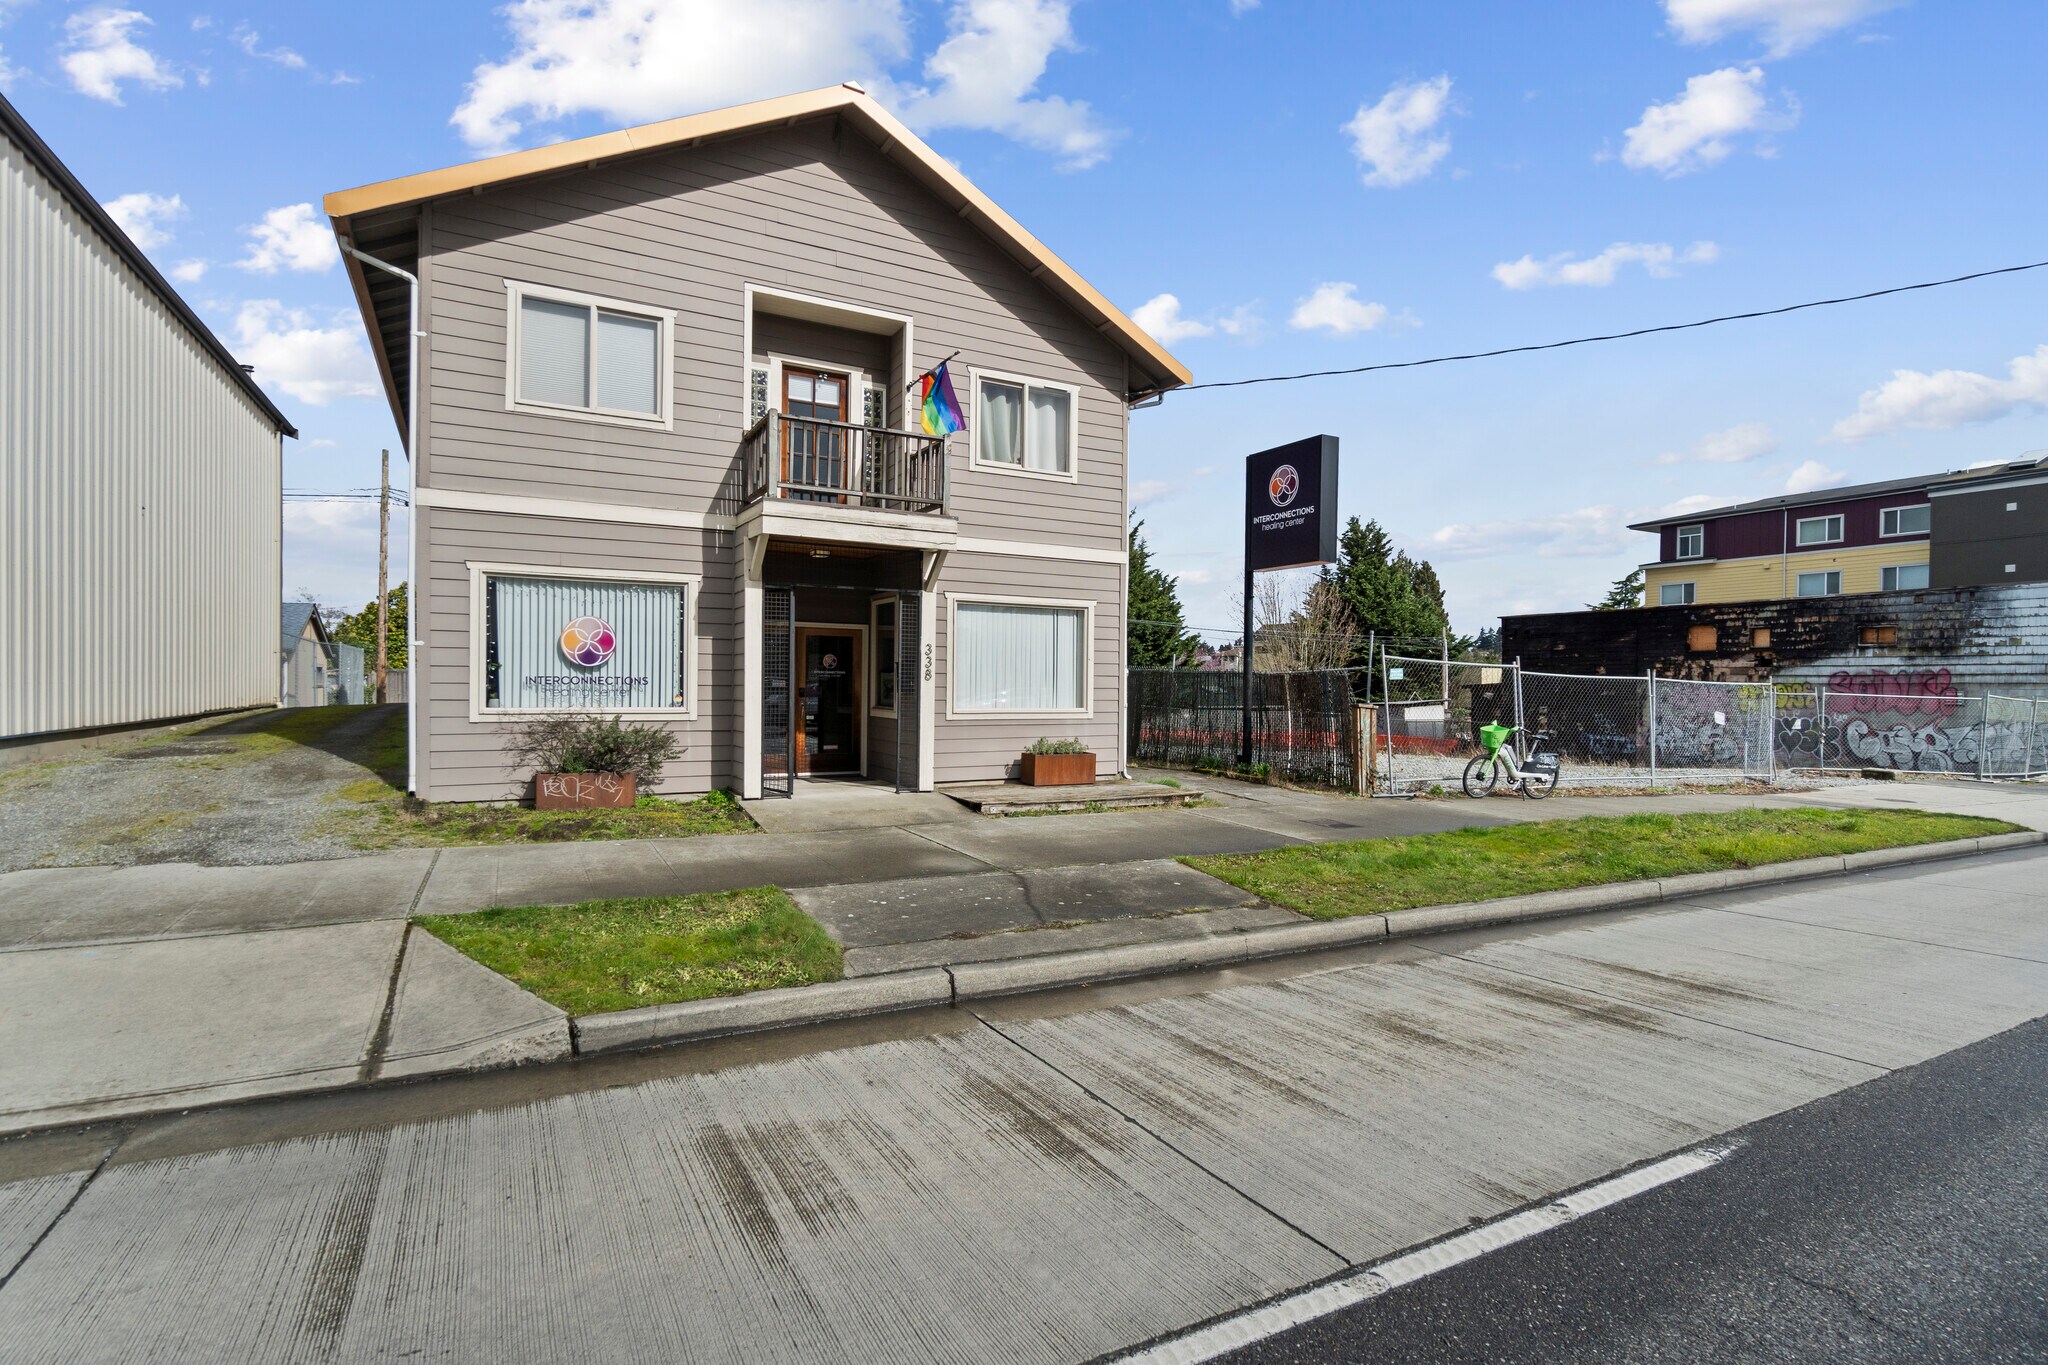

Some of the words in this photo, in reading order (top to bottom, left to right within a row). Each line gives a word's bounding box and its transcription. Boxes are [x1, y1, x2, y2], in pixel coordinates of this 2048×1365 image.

[1253, 505, 1314, 524] INTERCONNECTIONS
[1261, 521, 1285, 531] healing
[1285, 517, 1305, 527] center
[924, 643, 932, 681] 338
[525, 675, 649, 686] INTERCONNECTIONS
[545, 685, 590, 699] healing
[594, 686, 629, 697] center
